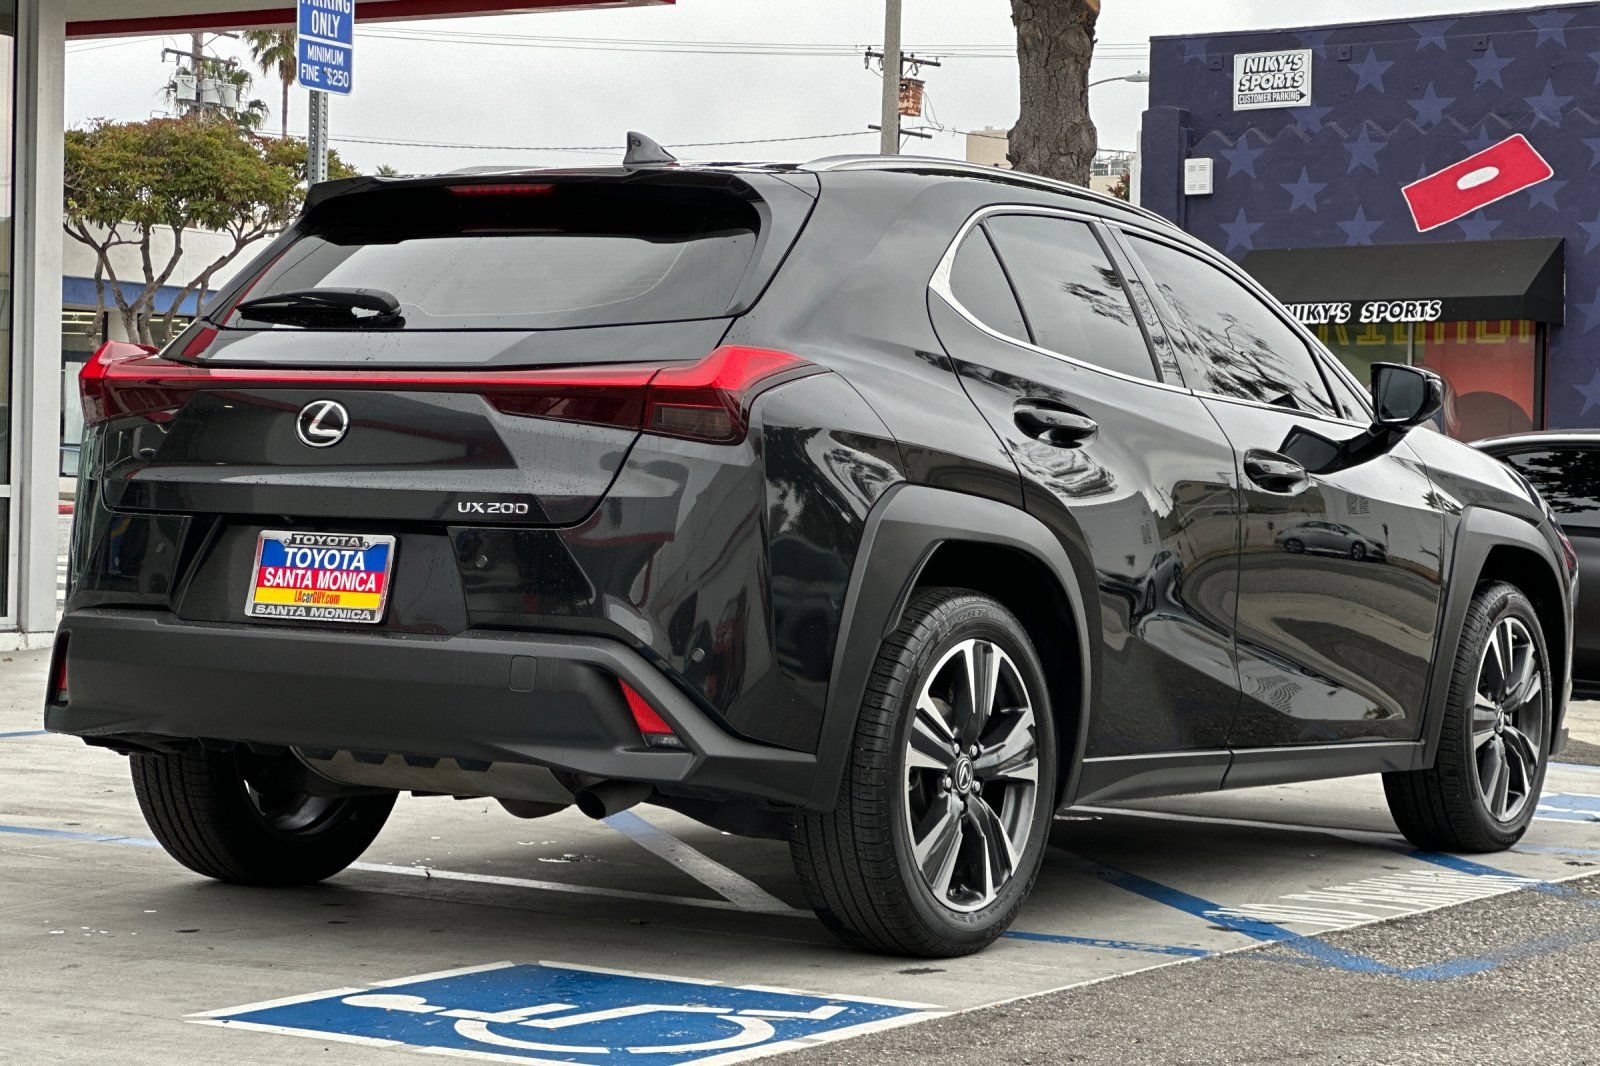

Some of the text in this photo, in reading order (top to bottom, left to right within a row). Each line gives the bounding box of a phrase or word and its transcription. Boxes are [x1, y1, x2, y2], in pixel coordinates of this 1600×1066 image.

[301, 0, 351, 14] KING
[311, 9, 340, 38] ONLY
[307, 43, 344, 67] MINIMUM
[1243, 53, 1304, 74] NIKY'S
[301, 63, 349, 88] FINE $250
[1238, 71, 1305, 92] SPORTS
[1239, 91, 1300, 104] CUSTOMER PARKING
[1359, 299, 1443, 323] SPORTS
[457, 501, 485, 514] UX
[294, 534, 360, 547] TOYOTA
[284, 548, 365, 571] TOYOTA
[263, 567, 376, 592] SANTA MONICA
[255, 604, 371, 620] SANTA MONICA
